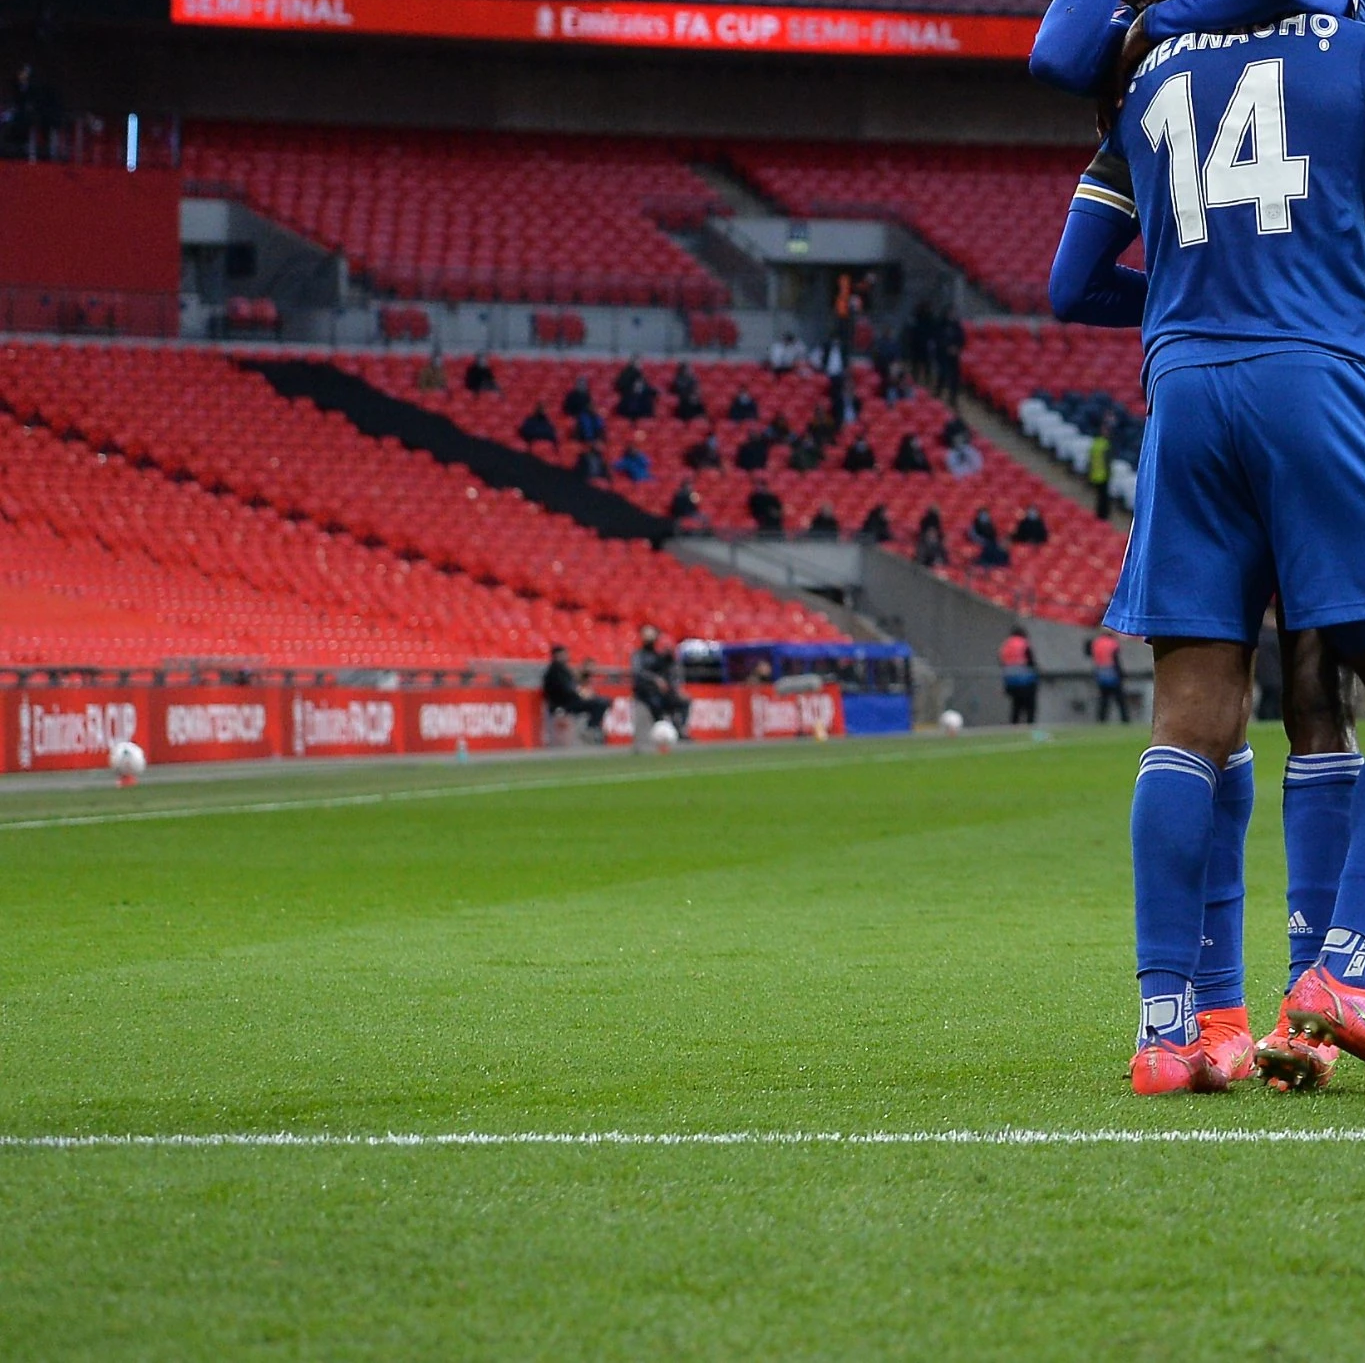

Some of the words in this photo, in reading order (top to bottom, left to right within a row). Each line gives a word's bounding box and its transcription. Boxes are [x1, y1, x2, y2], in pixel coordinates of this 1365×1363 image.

[560, 7, 669, 36] Emirates
[673, 11, 712, 41] FA
[716, 13, 781, 43] CUP
[787, 17, 961, 51] SEMI-FINAL
[1141, 58, 1309, 248] 14
